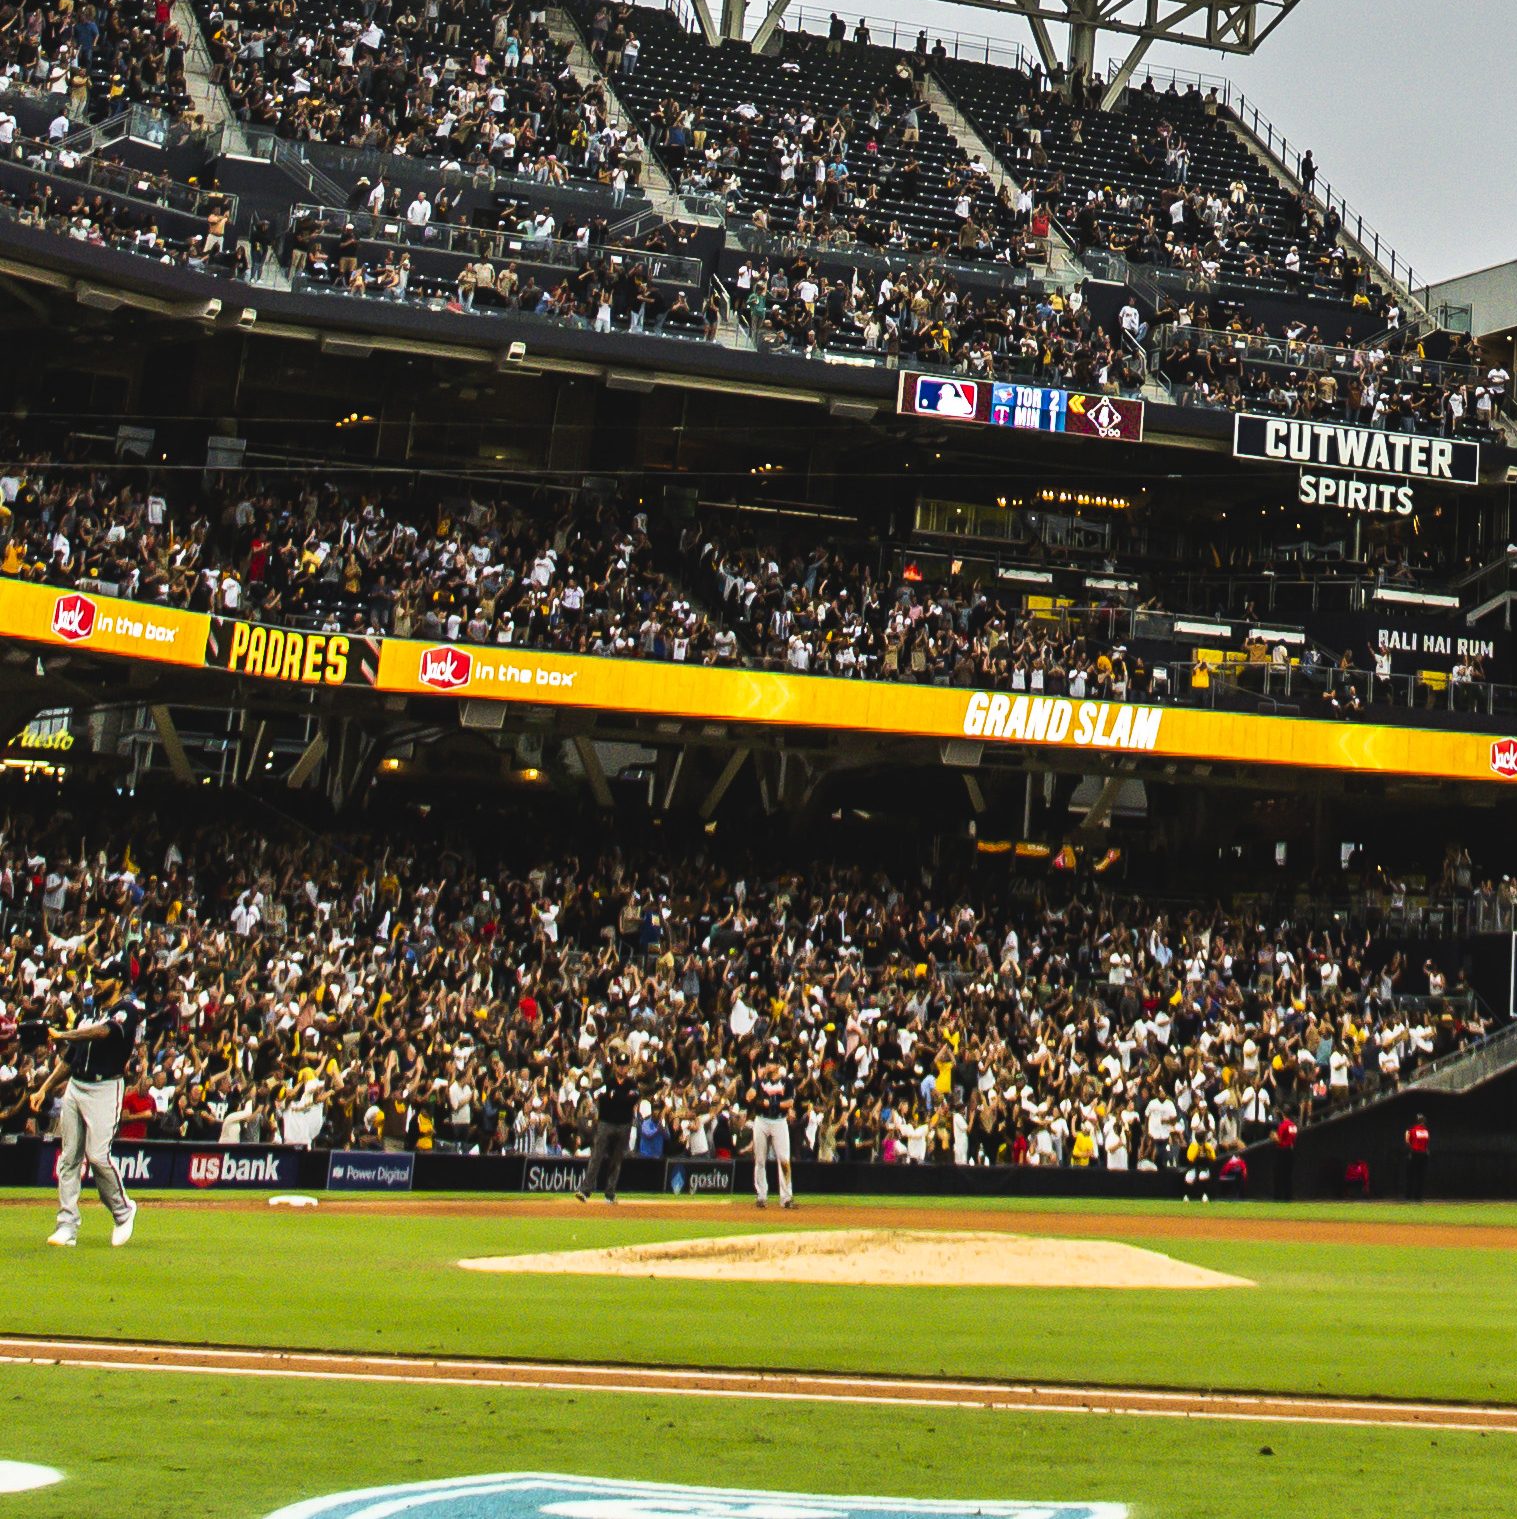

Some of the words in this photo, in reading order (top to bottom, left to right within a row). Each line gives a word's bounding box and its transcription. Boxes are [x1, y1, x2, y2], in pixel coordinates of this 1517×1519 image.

[1016, 386, 1042, 409] TOR
[1049, 391, 1059, 410] 2
[1013, 407, 1040, 428] MIN
[1049, 410, 1057, 432] 1
[1265, 420, 1452, 478] CUTWATER
[1300, 475, 1413, 515] SPIRITS
[54, 601, 92, 635] Jack
[98, 613, 114, 633] in
[117, 616, 144, 638] the
[145, 620, 176, 643] box
[228, 622, 349, 685] PADRES
[1379, 629, 1417, 653] BALI
[1423, 634, 1450, 654] HAI
[1457, 638, 1493, 658] RUM
[422, 651, 468, 684] Jack
[476, 662, 493, 680] in
[498, 665, 532, 683] the
[536, 668, 574, 687] box
[963, 692, 1072, 742] GRAND
[1073, 702, 1163, 749] SLAM
[347, 1165, 376, 1180] Power
[378, 1165, 409, 1186] Digital
[528, 1166, 586, 1191] StubHu
